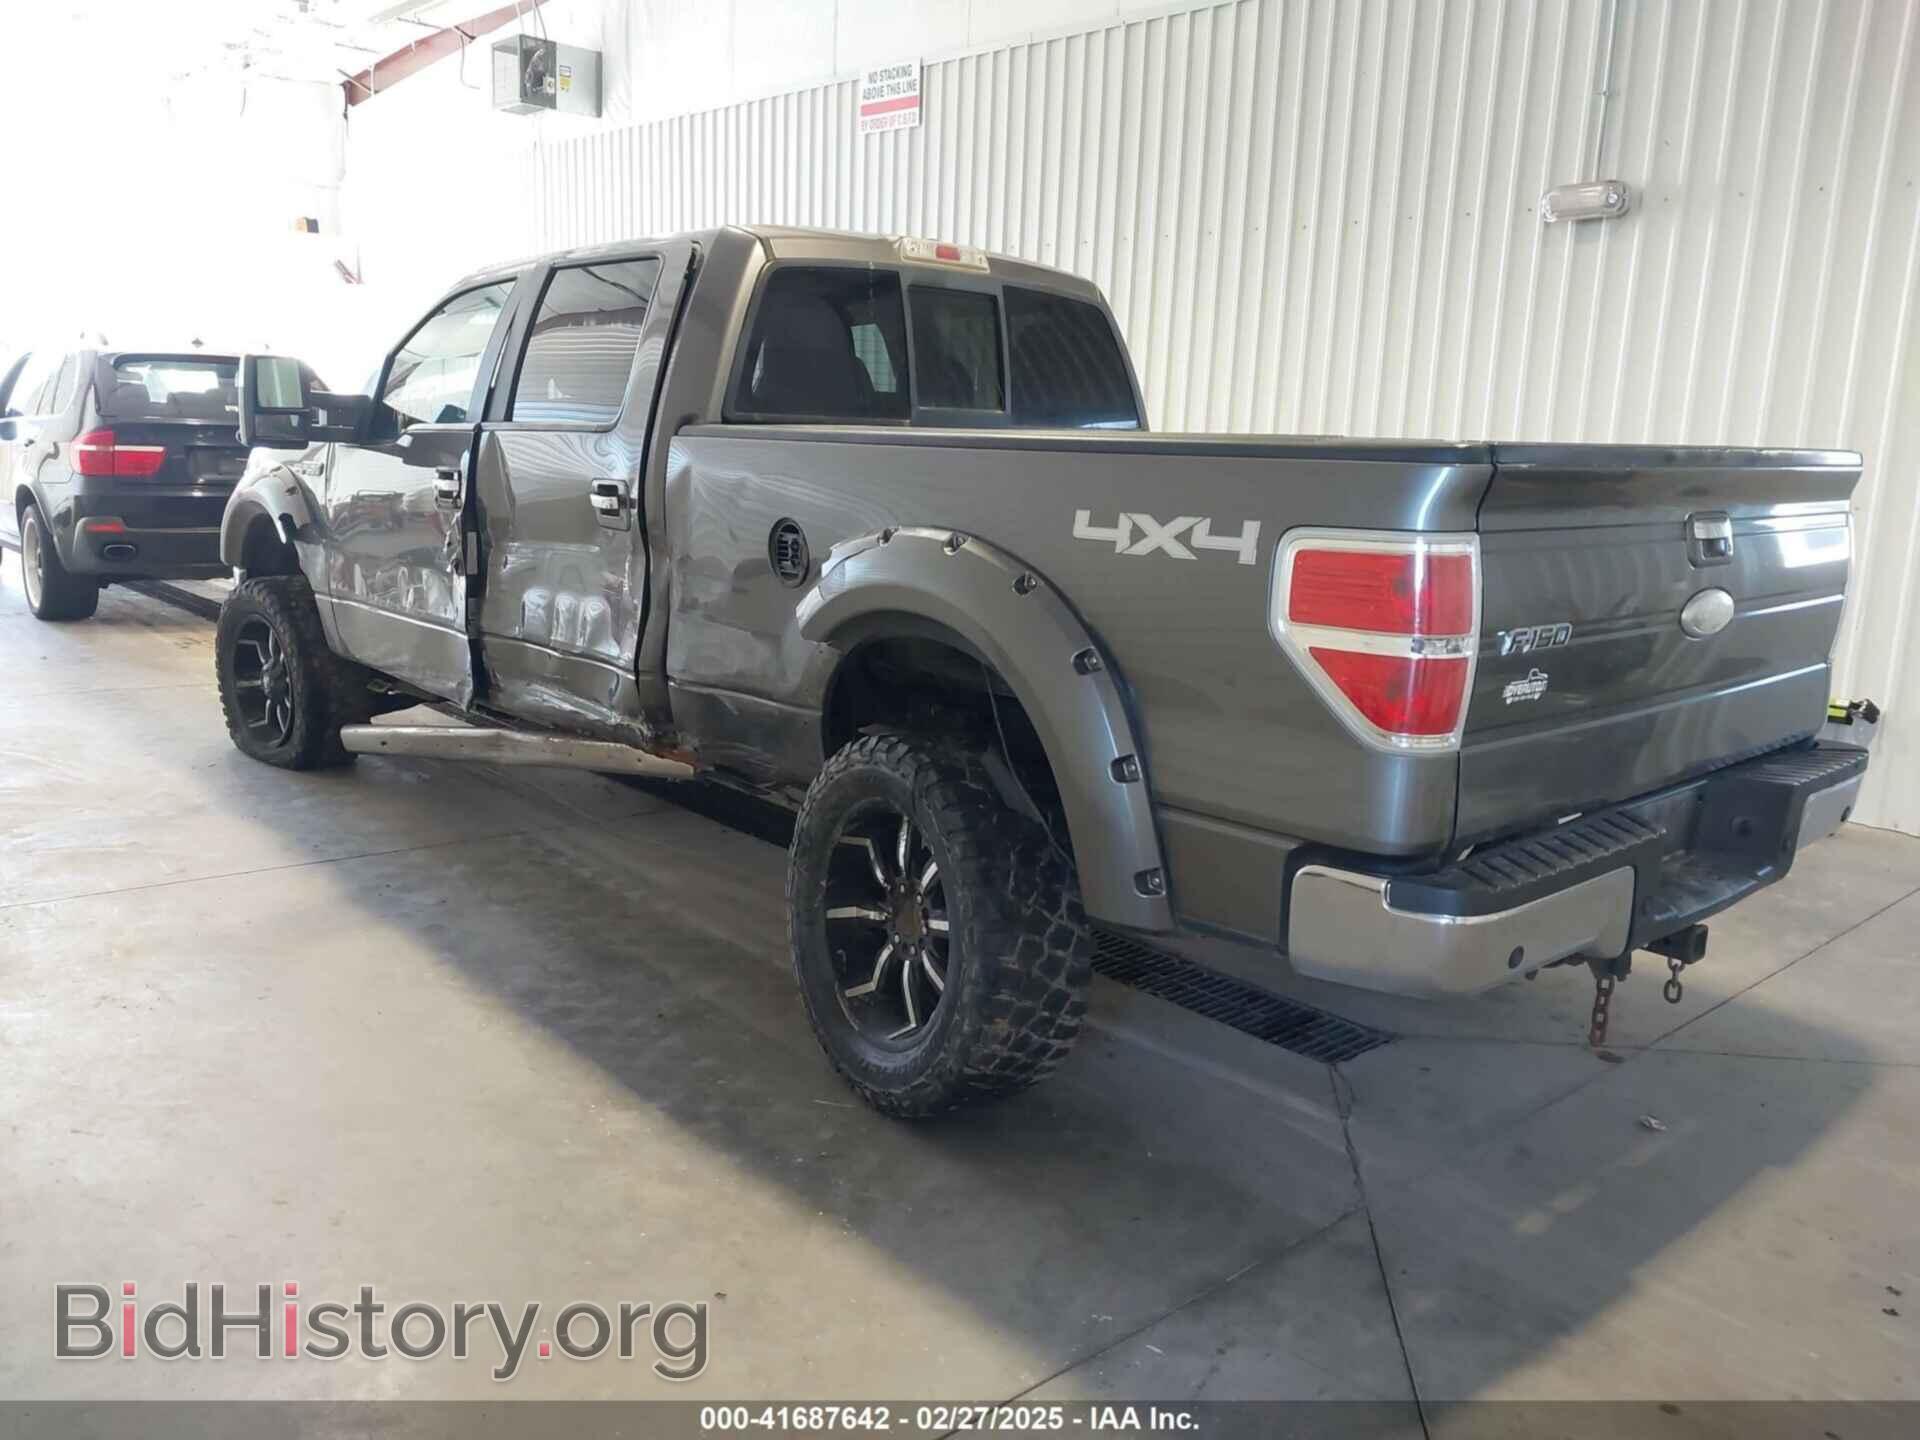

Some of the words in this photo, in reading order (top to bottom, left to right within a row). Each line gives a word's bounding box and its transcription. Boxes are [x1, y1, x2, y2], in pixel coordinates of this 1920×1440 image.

[867, 72, 878, 84] NO
[879, 64, 913, 82] STACKING
[863, 85, 885, 100] ABOVE
[886, 82, 901, 97] THIS
[902, 78, 918, 93] LINE
